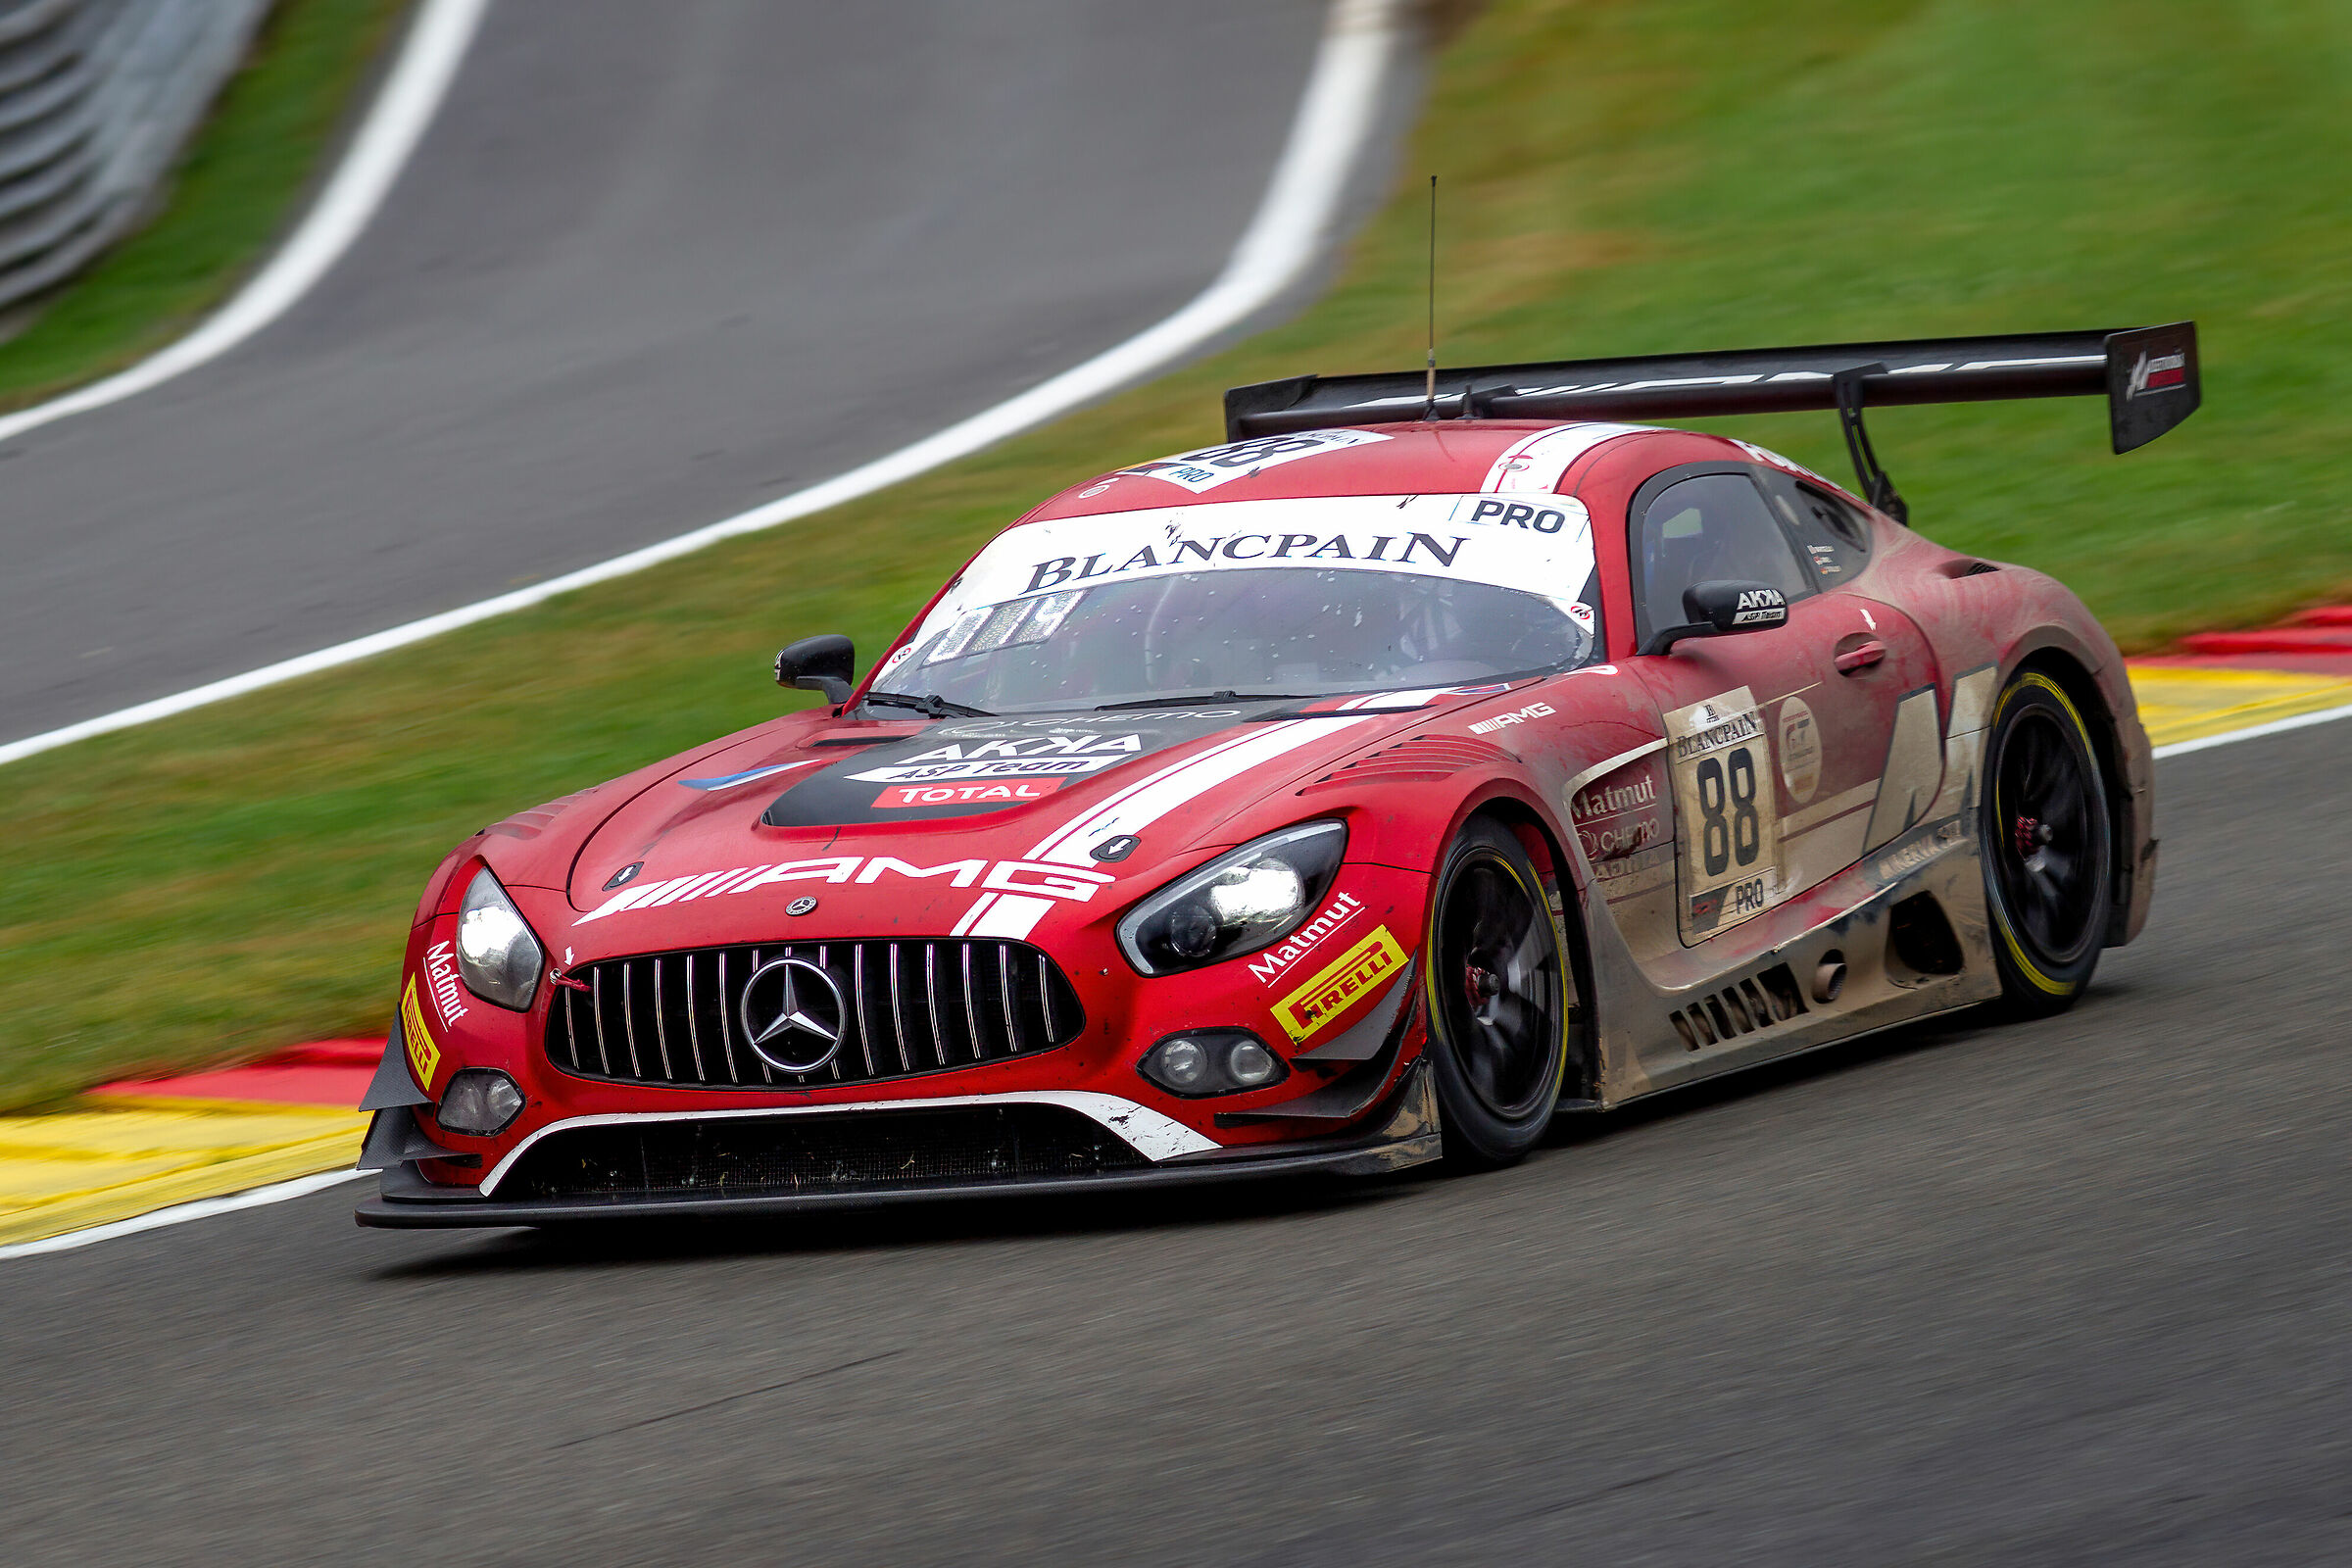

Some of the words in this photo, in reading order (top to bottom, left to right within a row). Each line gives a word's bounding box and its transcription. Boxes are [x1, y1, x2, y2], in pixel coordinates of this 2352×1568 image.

[1168, 466, 1215, 483] PRO
[1470, 500, 1566, 534] PRO
[1018, 532, 1471, 595] BLANCPAIN
[1677, 710, 1759, 759] BLANCPAIN
[899, 783, 1042, 805] TOTAL
[1696, 747, 1760, 877] 88
[1736, 878, 1764, 914] PRO
[1248, 891, 1361, 984] Matmut
[426, 940, 469, 1027] Matmut
[1288, 941, 1394, 1030] PIRELLI
[405, 988, 432, 1075] PIRELLI
